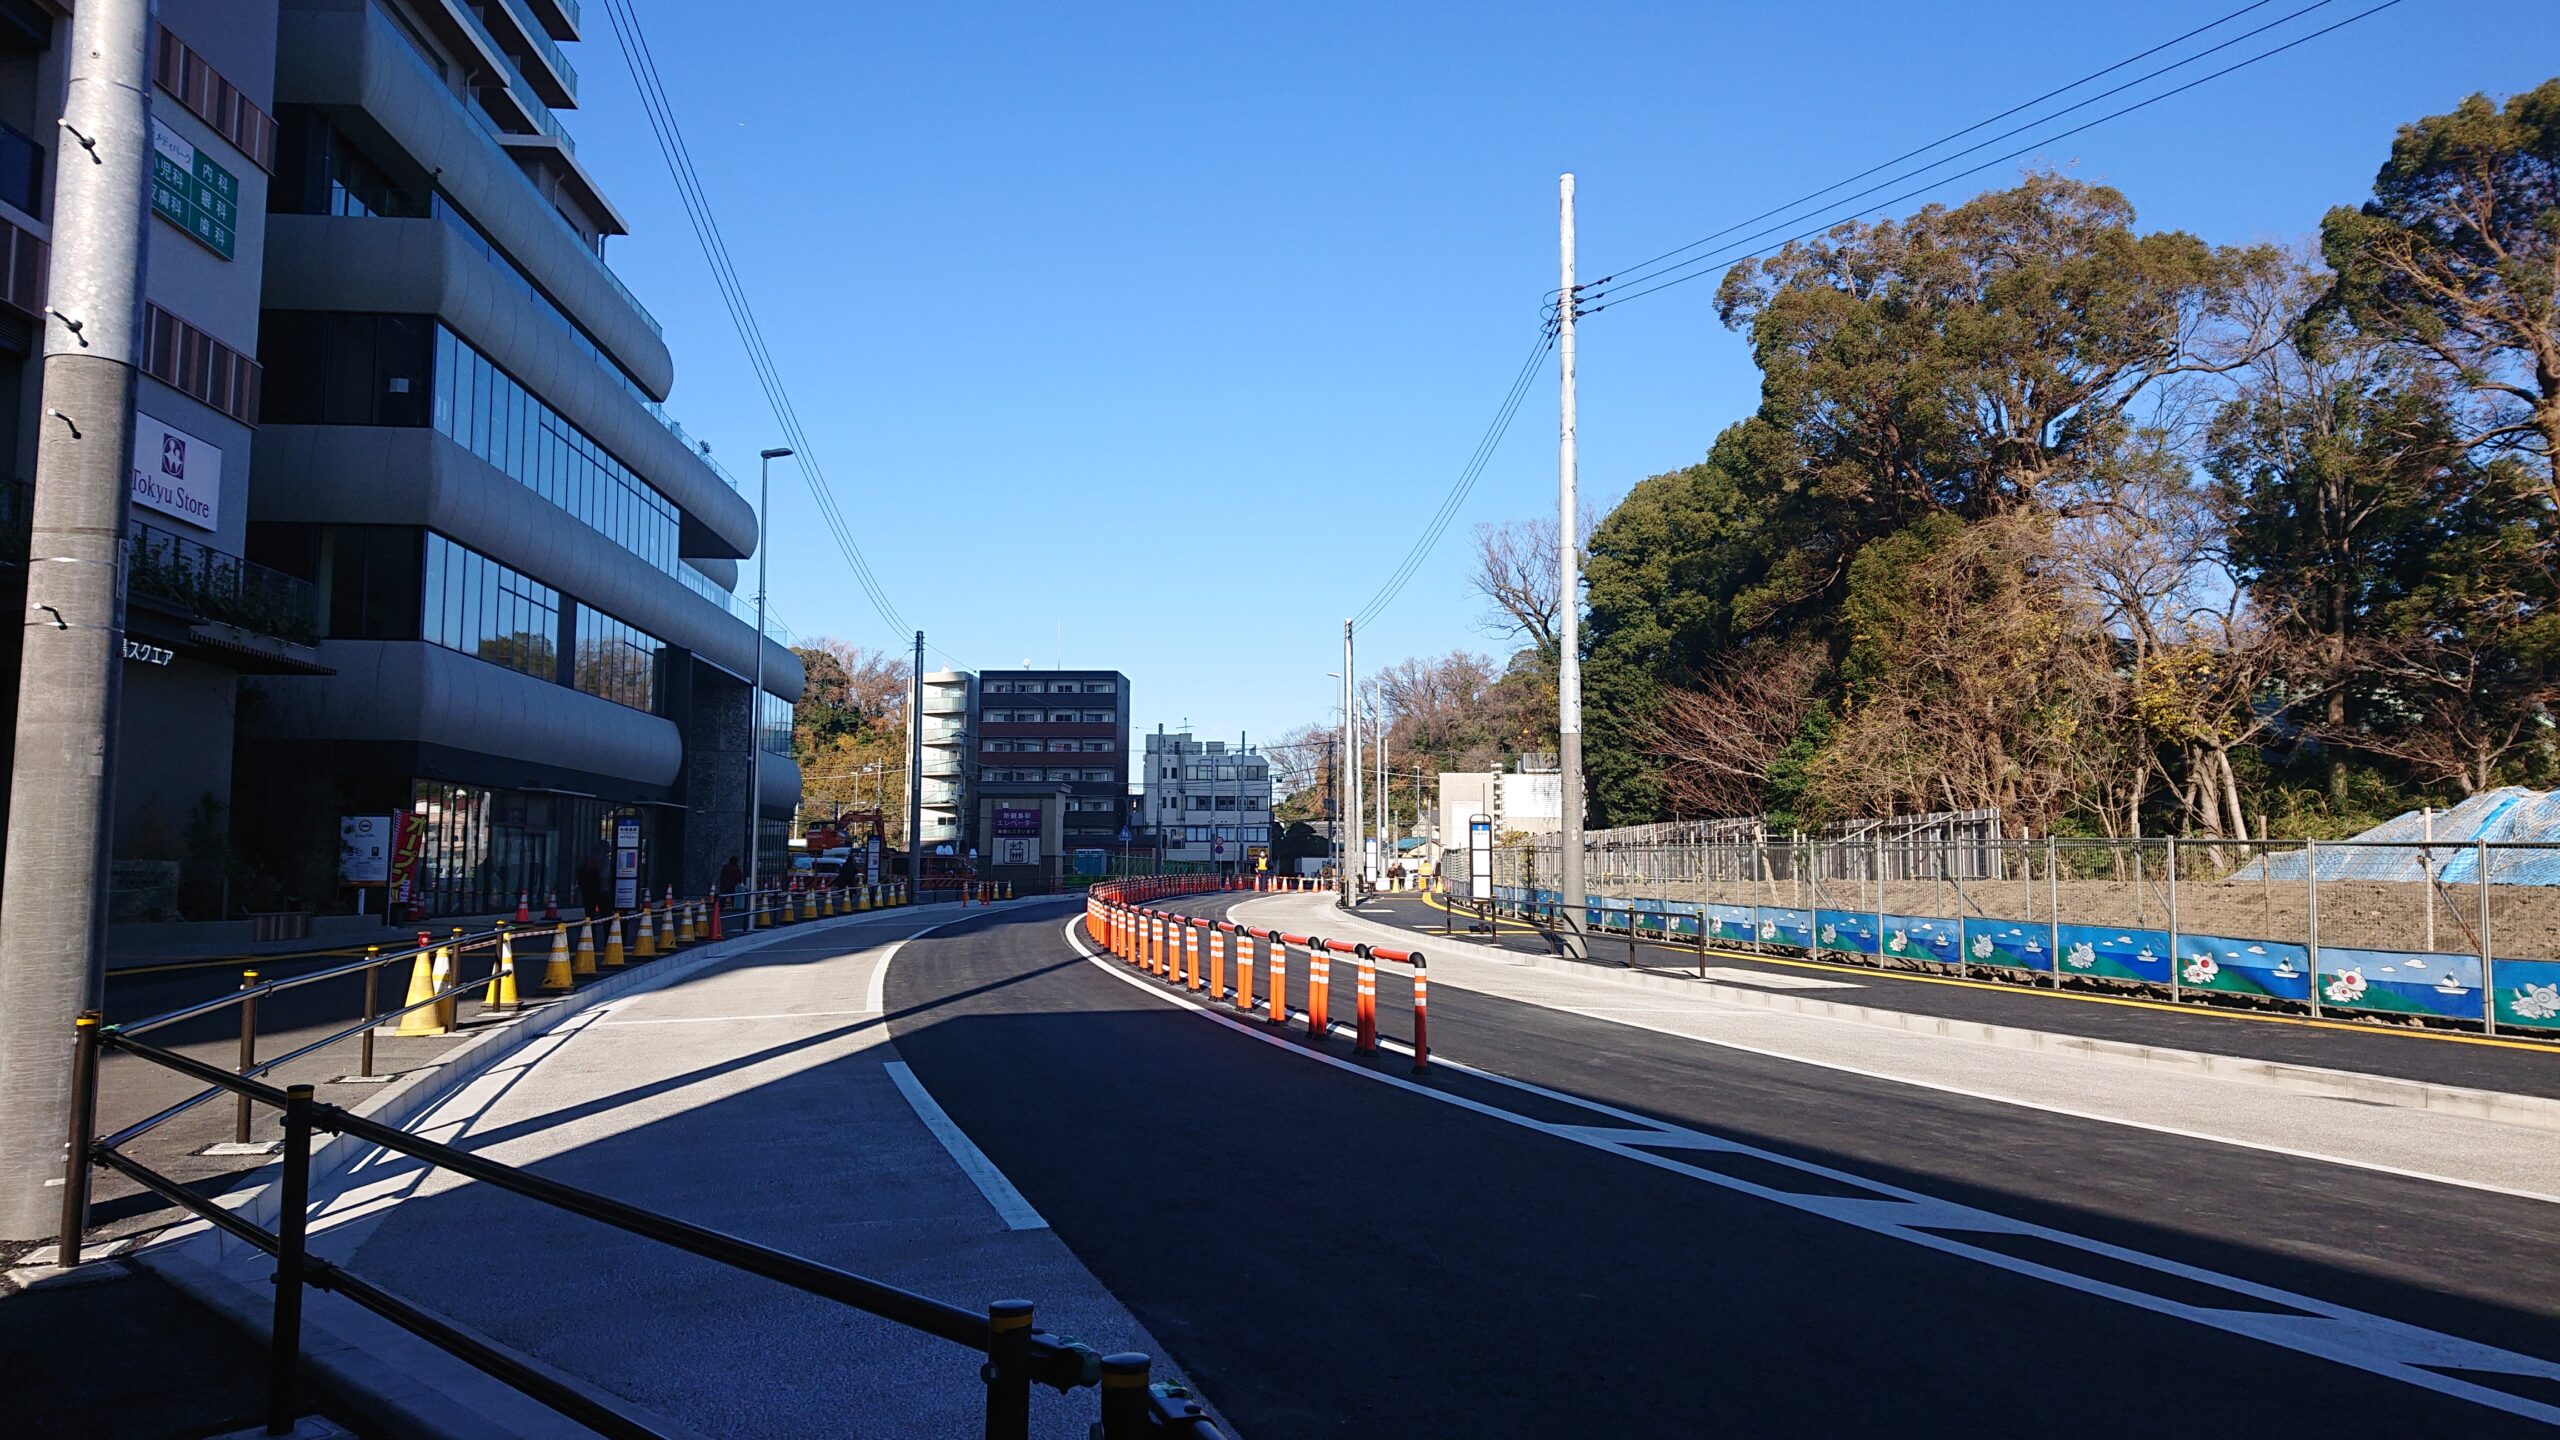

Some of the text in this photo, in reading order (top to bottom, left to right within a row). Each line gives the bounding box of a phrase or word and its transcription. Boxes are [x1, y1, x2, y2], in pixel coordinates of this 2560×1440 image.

[152, 131, 191, 163] メディパーク
[203, 163, 228, 194] 内科
[201, 188, 226, 220] 眼科
[200, 217, 224, 246] 歯科
[132, 469, 209, 518] Tokyu Store
[123, 638, 173, 666] スクエア
